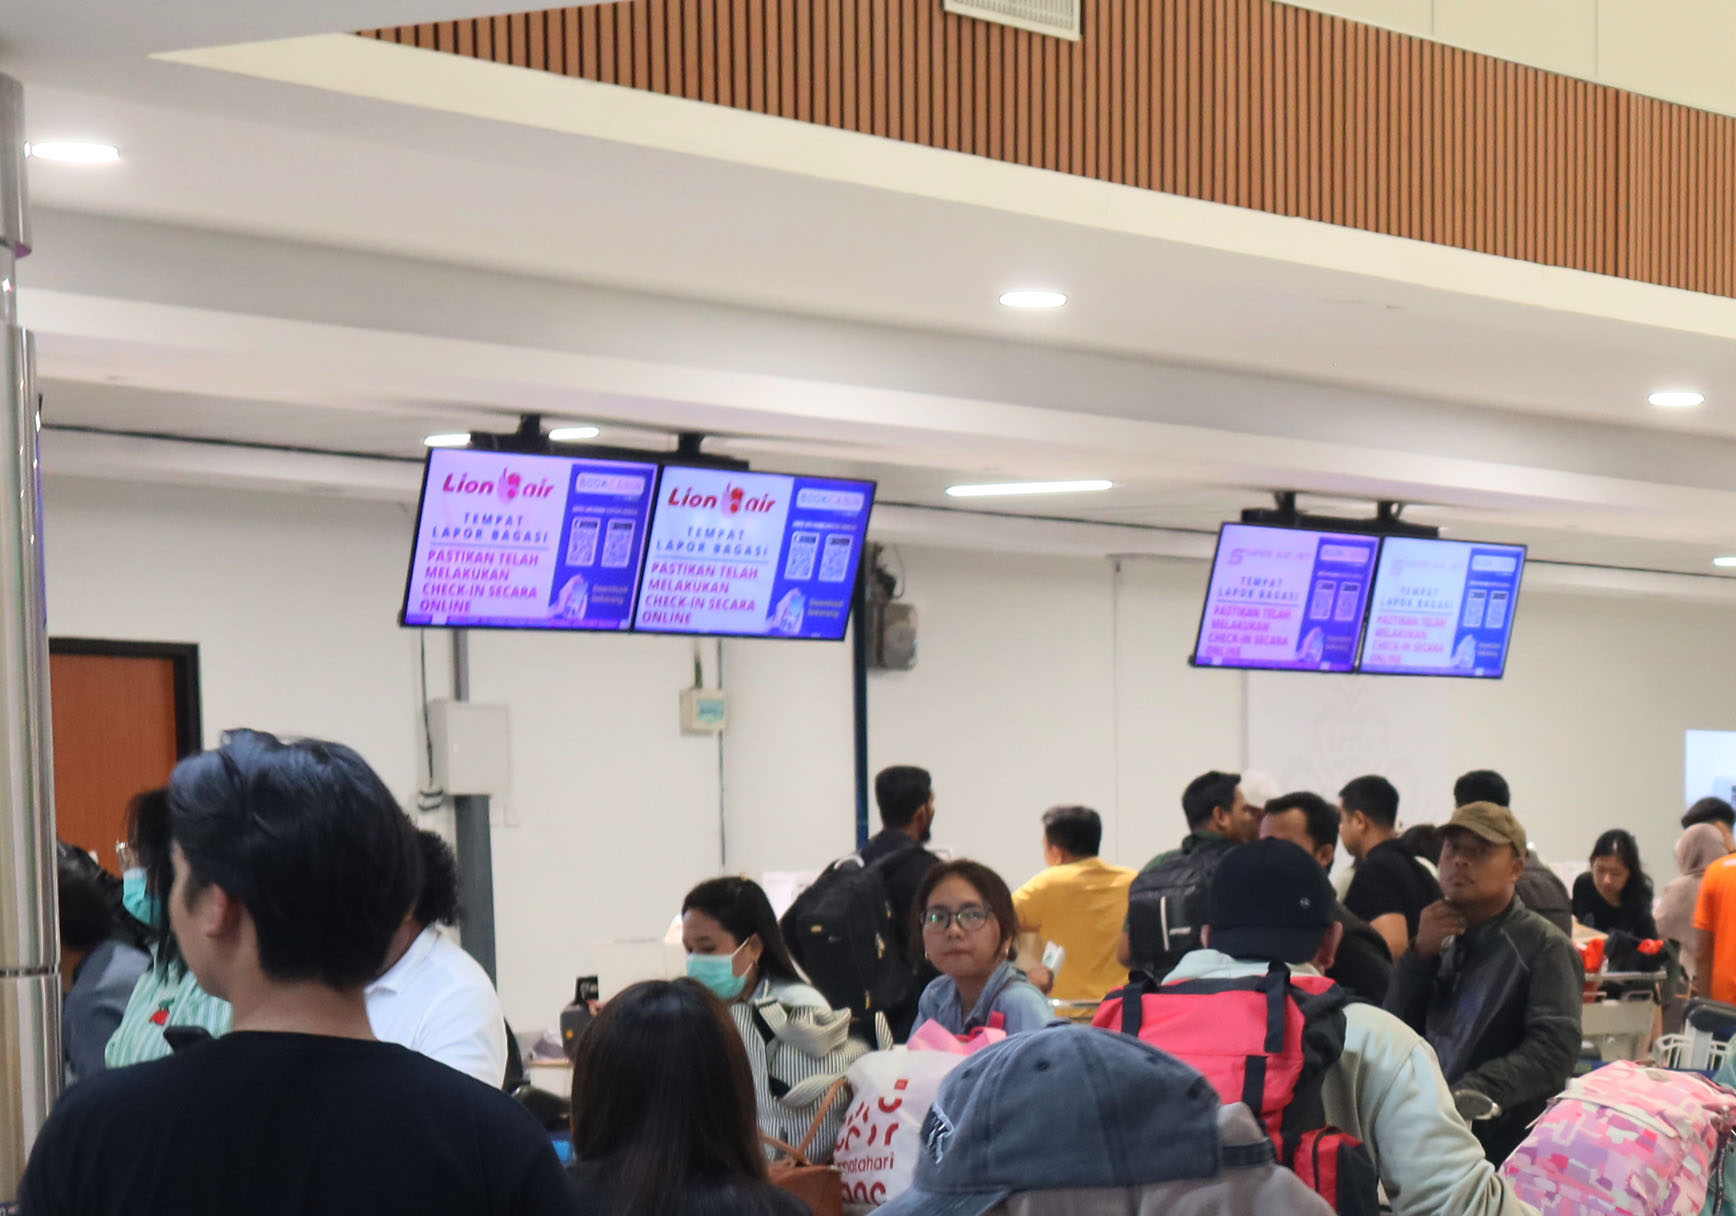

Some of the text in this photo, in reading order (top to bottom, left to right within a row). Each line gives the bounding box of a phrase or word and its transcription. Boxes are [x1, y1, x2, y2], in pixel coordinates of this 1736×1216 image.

[442, 471, 555, 498] Lion air
[668, 487, 776, 514] Lion air
[464, 512, 524, 526] TEMPAT
[432, 525, 548, 542] LAPOR BAGASI
[687, 525, 744, 541] TEMPAT
[656, 540, 768, 558] LAPOR BAGASI
[427, 550, 540, 567] PASTIKAN TELAH
[424, 566, 510, 581] MELAKUKAN
[651, 561, 758, 579] PASTIKAN TELAH
[488, 585, 538, 599] SECARA
[648, 578, 730, 594] MELAKUKAN
[419, 599, 472, 614] ONLINE
[708, 598, 755, 612] SECARA
[642, 611, 692, 625] ONLINE
